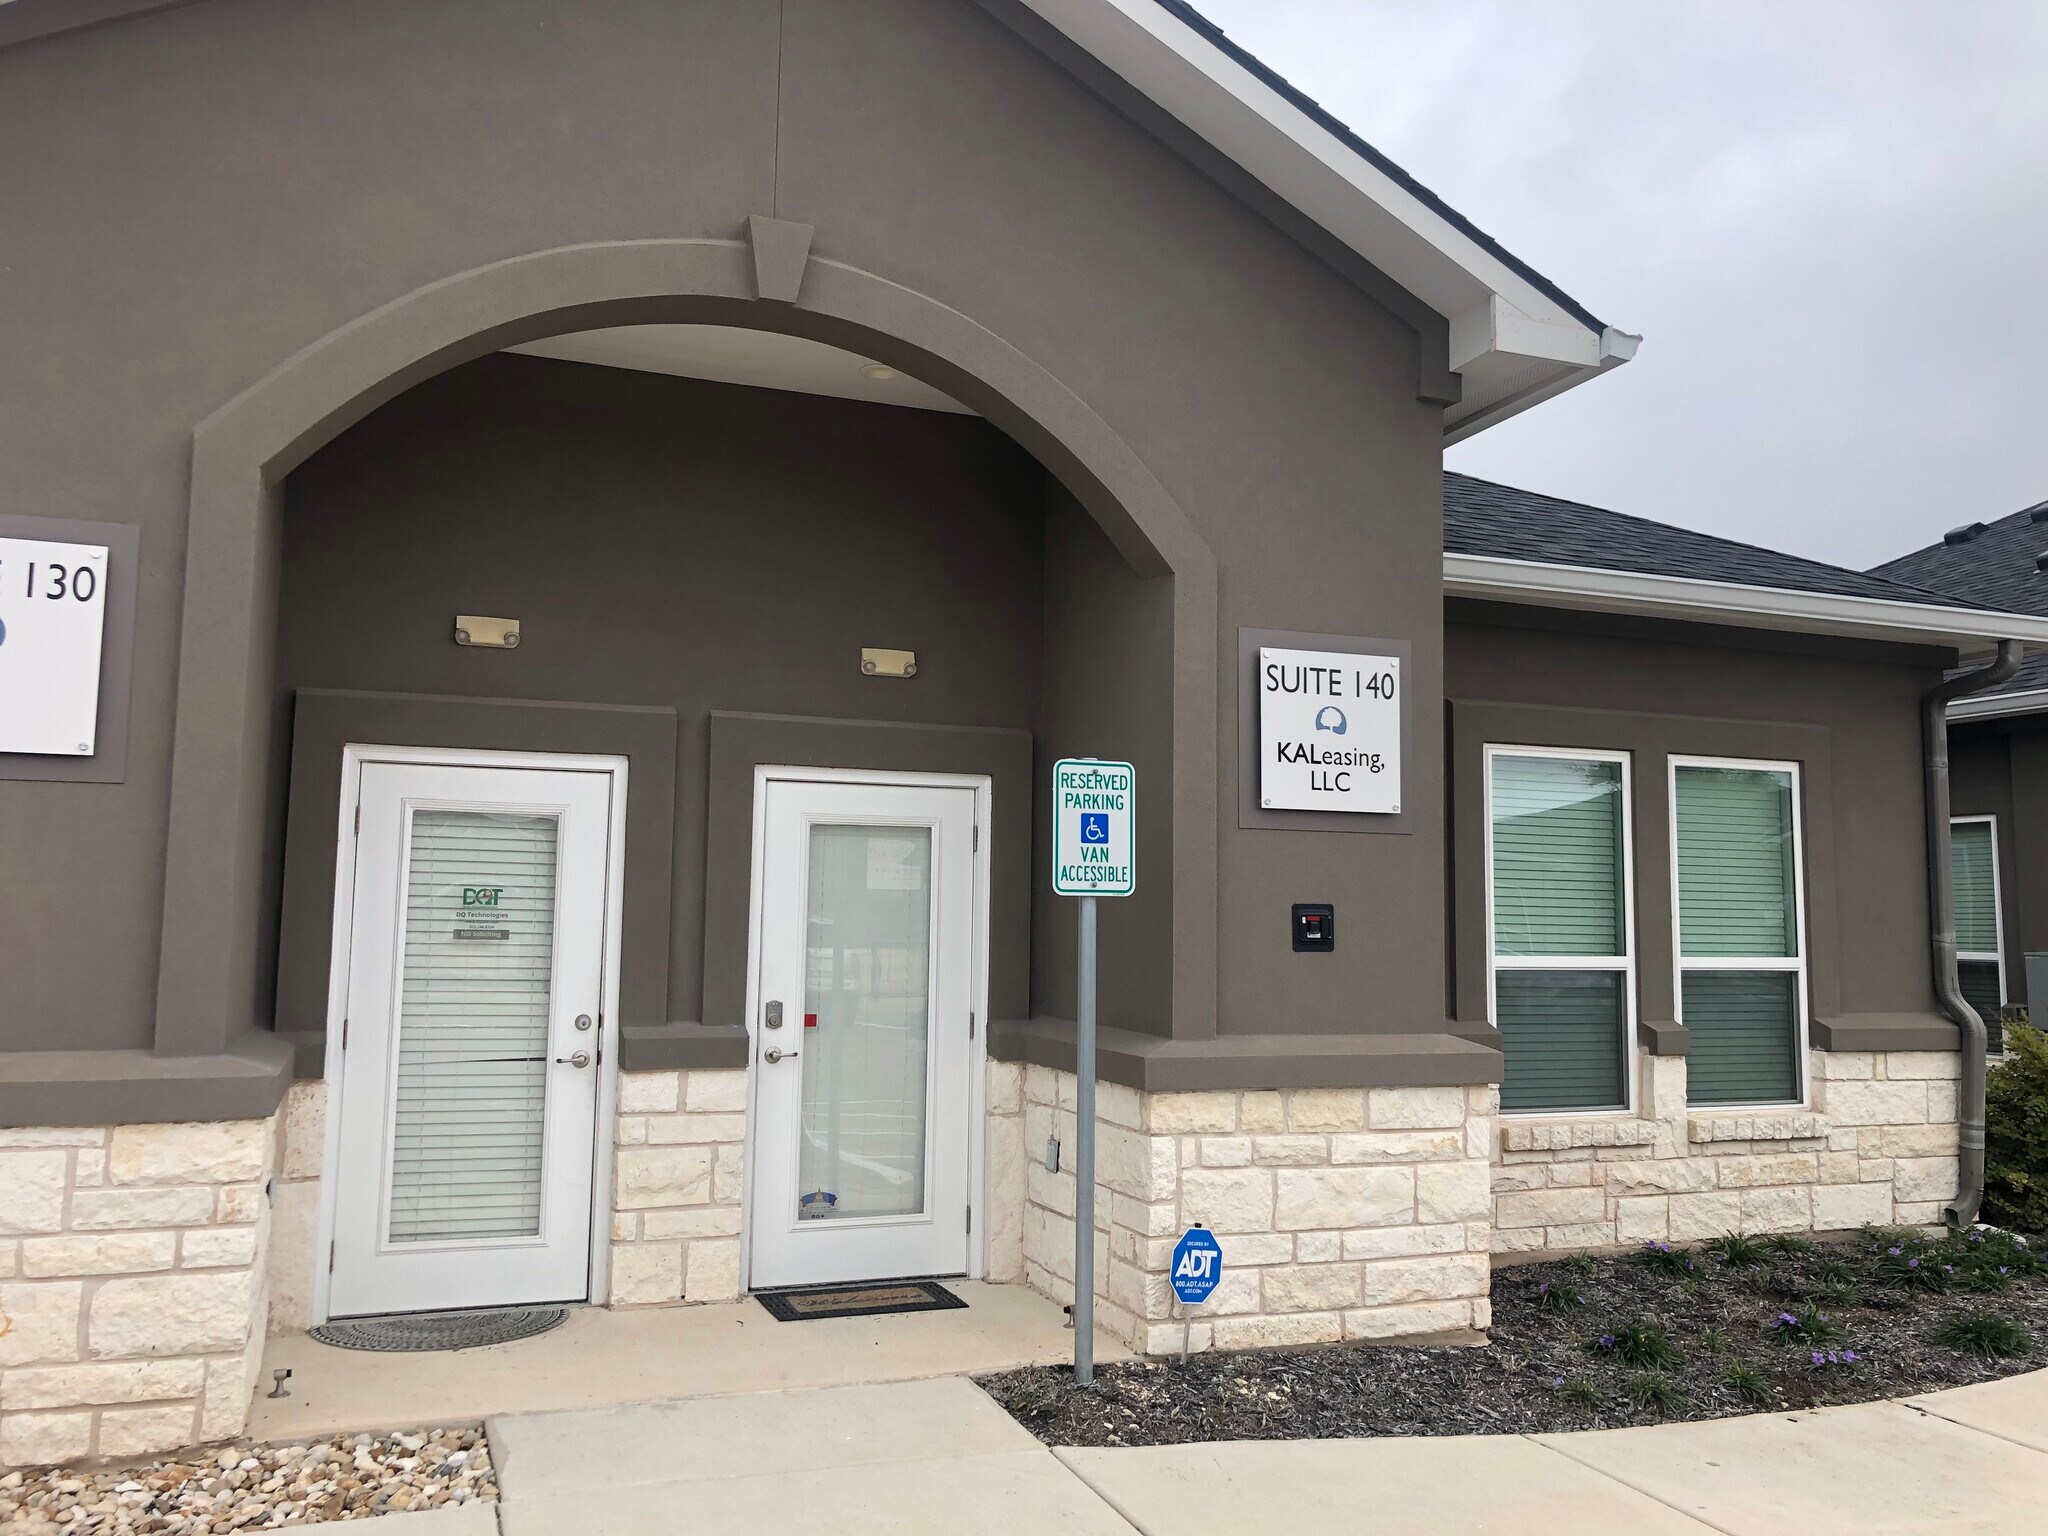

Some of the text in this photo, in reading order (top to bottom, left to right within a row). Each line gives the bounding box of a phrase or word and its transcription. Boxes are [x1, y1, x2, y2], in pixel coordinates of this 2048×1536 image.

[26, 561, 97, 602] 130
[1266, 663, 1395, 700] SUITE 140
[1277, 741, 1385, 774] KALeasing,
[1061, 772, 1128, 791] RESERVED
[1311, 770, 1351, 792] LLC
[1065, 793, 1124, 811] PARKING
[1080, 846, 1109, 863] VAN
[1060, 865, 1128, 883] ACCESSIBLE
[468, 911, 509, 919] Technologies
[1175, 1249, 1218, 1278] ADT
